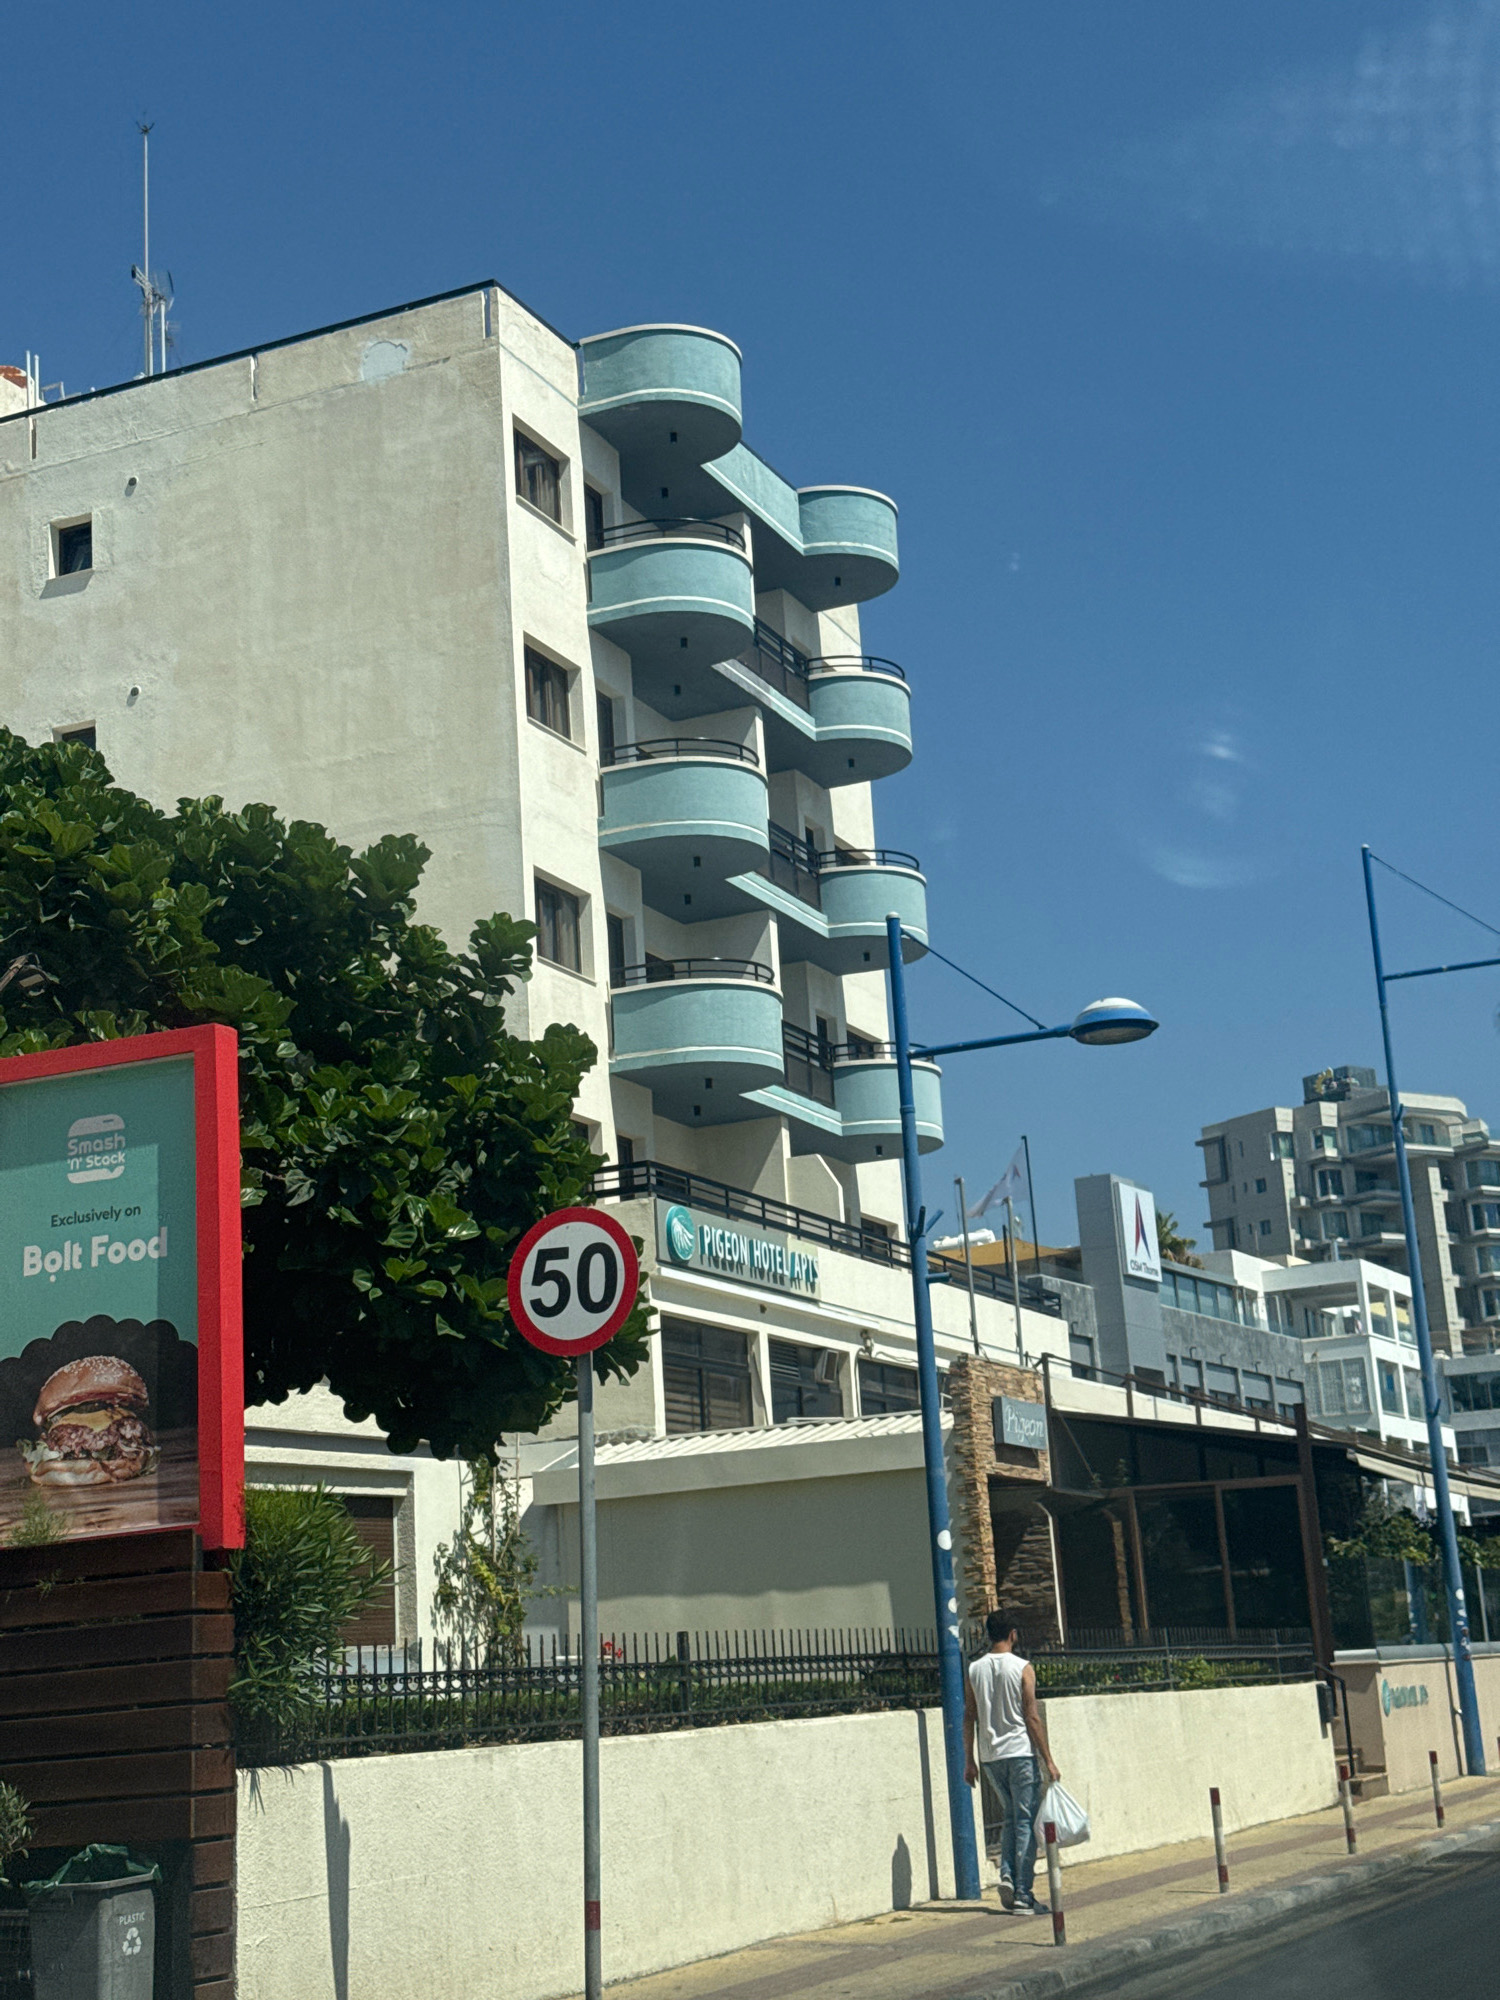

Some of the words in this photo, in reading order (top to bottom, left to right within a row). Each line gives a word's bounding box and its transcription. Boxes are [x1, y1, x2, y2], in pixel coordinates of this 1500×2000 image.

[67, 1133, 126, 1156] Smash
[86, 1151, 126, 1168] Stack
[51, 1207, 121, 1227] Exclusively
[125, 1206, 141, 1216] on
[23, 1240, 83, 1280] Bolt
[91, 1226, 168, 1267] Food
[701, 1224, 749, 1266] PIGEON
[752, 1238, 790, 1277] HOTEL
[530, 1242, 618, 1318] 50
[1004, 1405, 1044, 1442] Pigeon
[119, 1912, 145, 1925] PLASTIC
